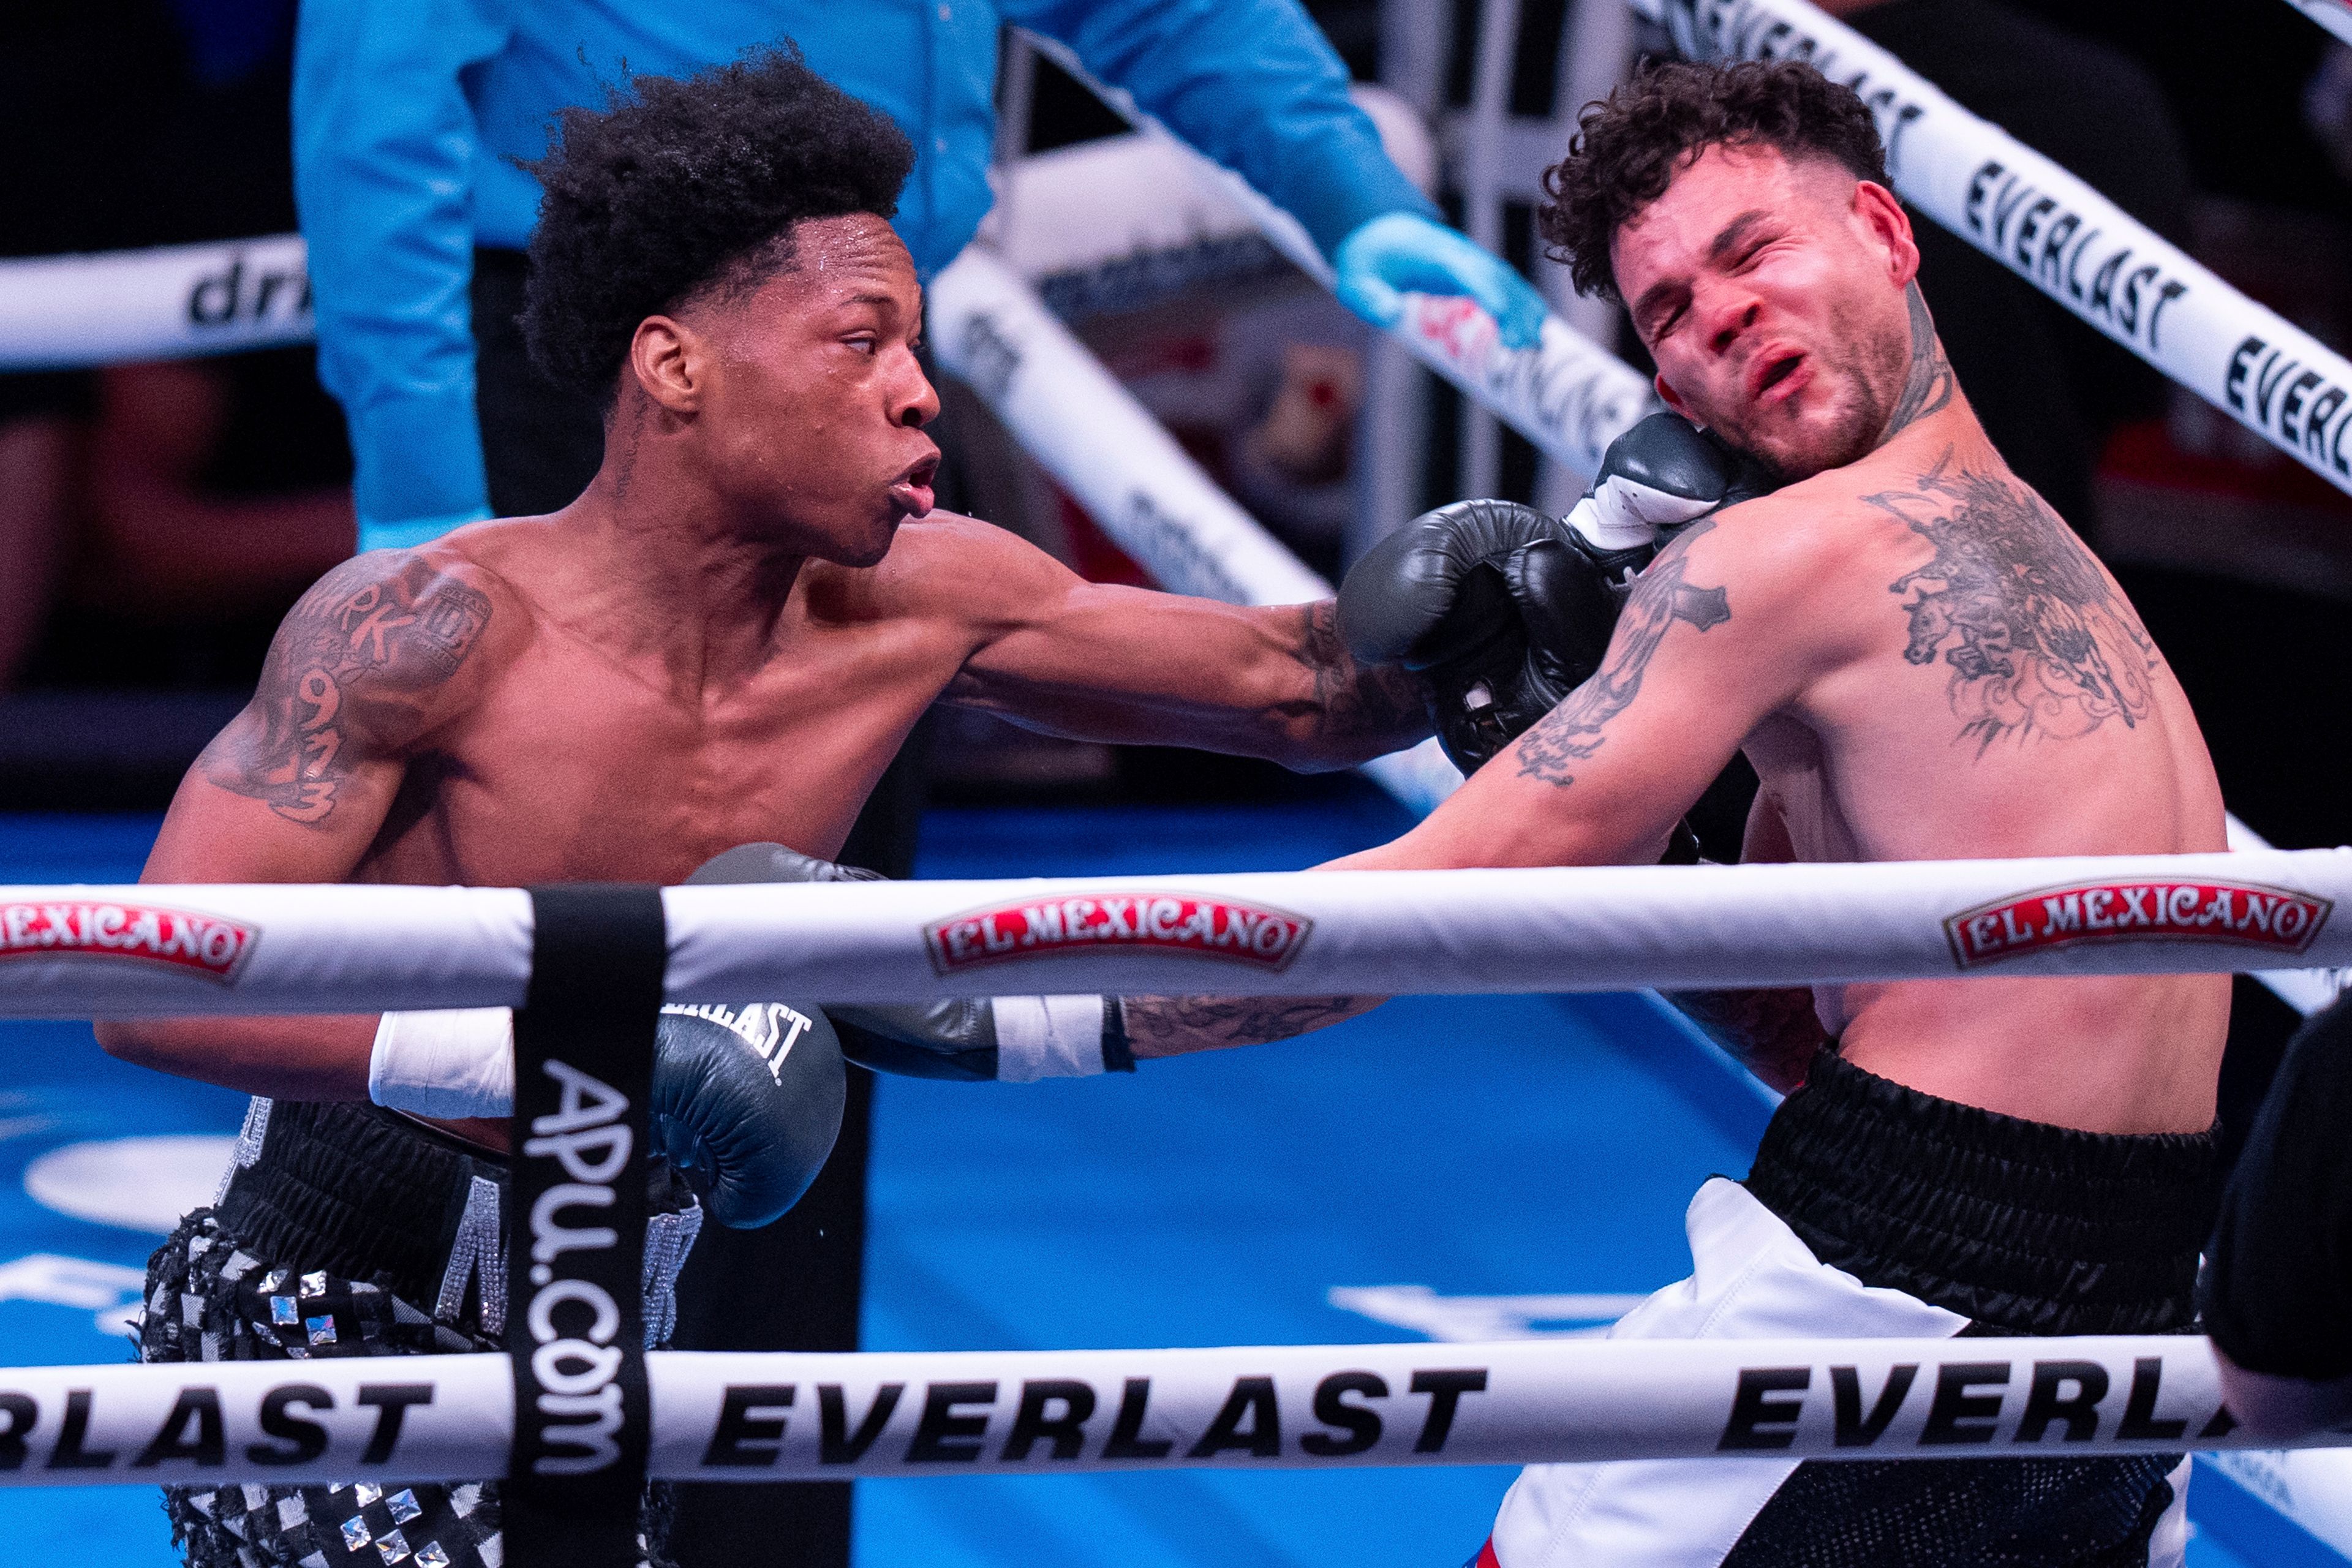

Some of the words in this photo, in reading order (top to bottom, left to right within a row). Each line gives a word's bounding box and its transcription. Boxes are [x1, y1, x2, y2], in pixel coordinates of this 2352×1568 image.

[1965, 160, 2188, 350] EVERLAST
[2225, 334, 2352, 477] EVERL
[0, 905, 236, 966] EXICANO
[945, 920, 1014, 960] EL
[1021, 897, 1289, 956] MEXICANO
[1967, 911, 2033, 954] EL
[2041, 886, 2308, 940] MEXICANO
[701, 1367, 1489, 1466] EVERLAST
[1715, 1357, 2239, 1450] EVERL
